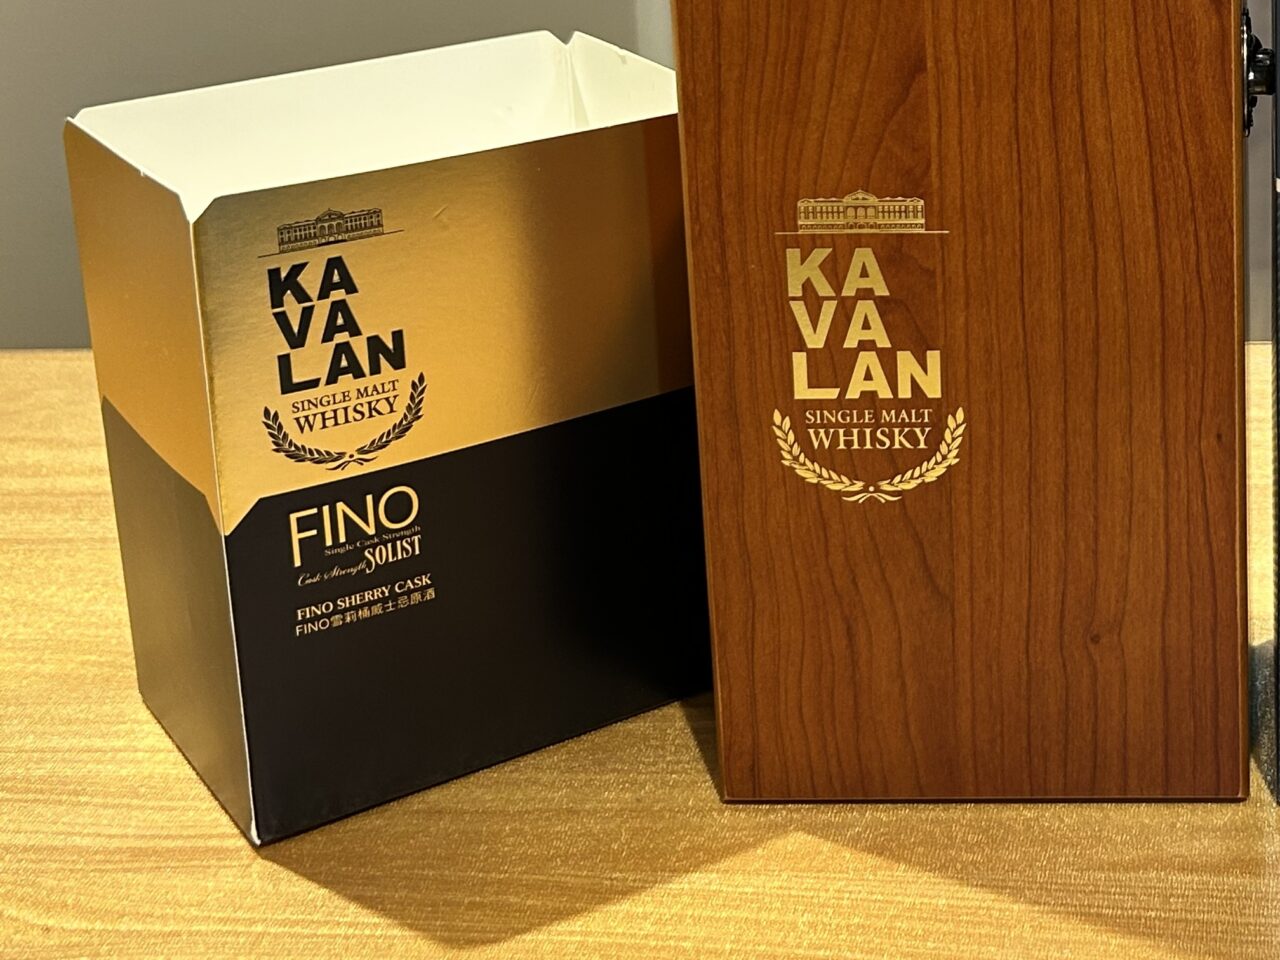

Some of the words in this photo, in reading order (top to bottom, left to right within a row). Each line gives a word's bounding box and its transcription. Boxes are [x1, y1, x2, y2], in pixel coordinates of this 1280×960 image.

[267, 255, 359, 309] KA
[785, 247, 890, 297] KA
[272, 299, 362, 349] VA
[789, 300, 892, 349] VA
[277, 328, 407, 395] LAN
[792, 350, 942, 399] LAN
[291, 390, 352, 413] SINGLE
[356, 379, 399, 400] MALT
[293, 394, 399, 434] WHISKY
[805, 409, 875, 424] SINGLE
[881, 408, 933, 423] MALT
[807, 427, 932, 450] WHISKY
[289, 485, 419, 568] FINO
[324, 542, 355, 557] Single
[364, 534, 421, 574] SOLIST
[296, 601, 334, 621] FINO
[337, 585, 391, 610] SHERRY
[394, 573, 432, 593] CASK
